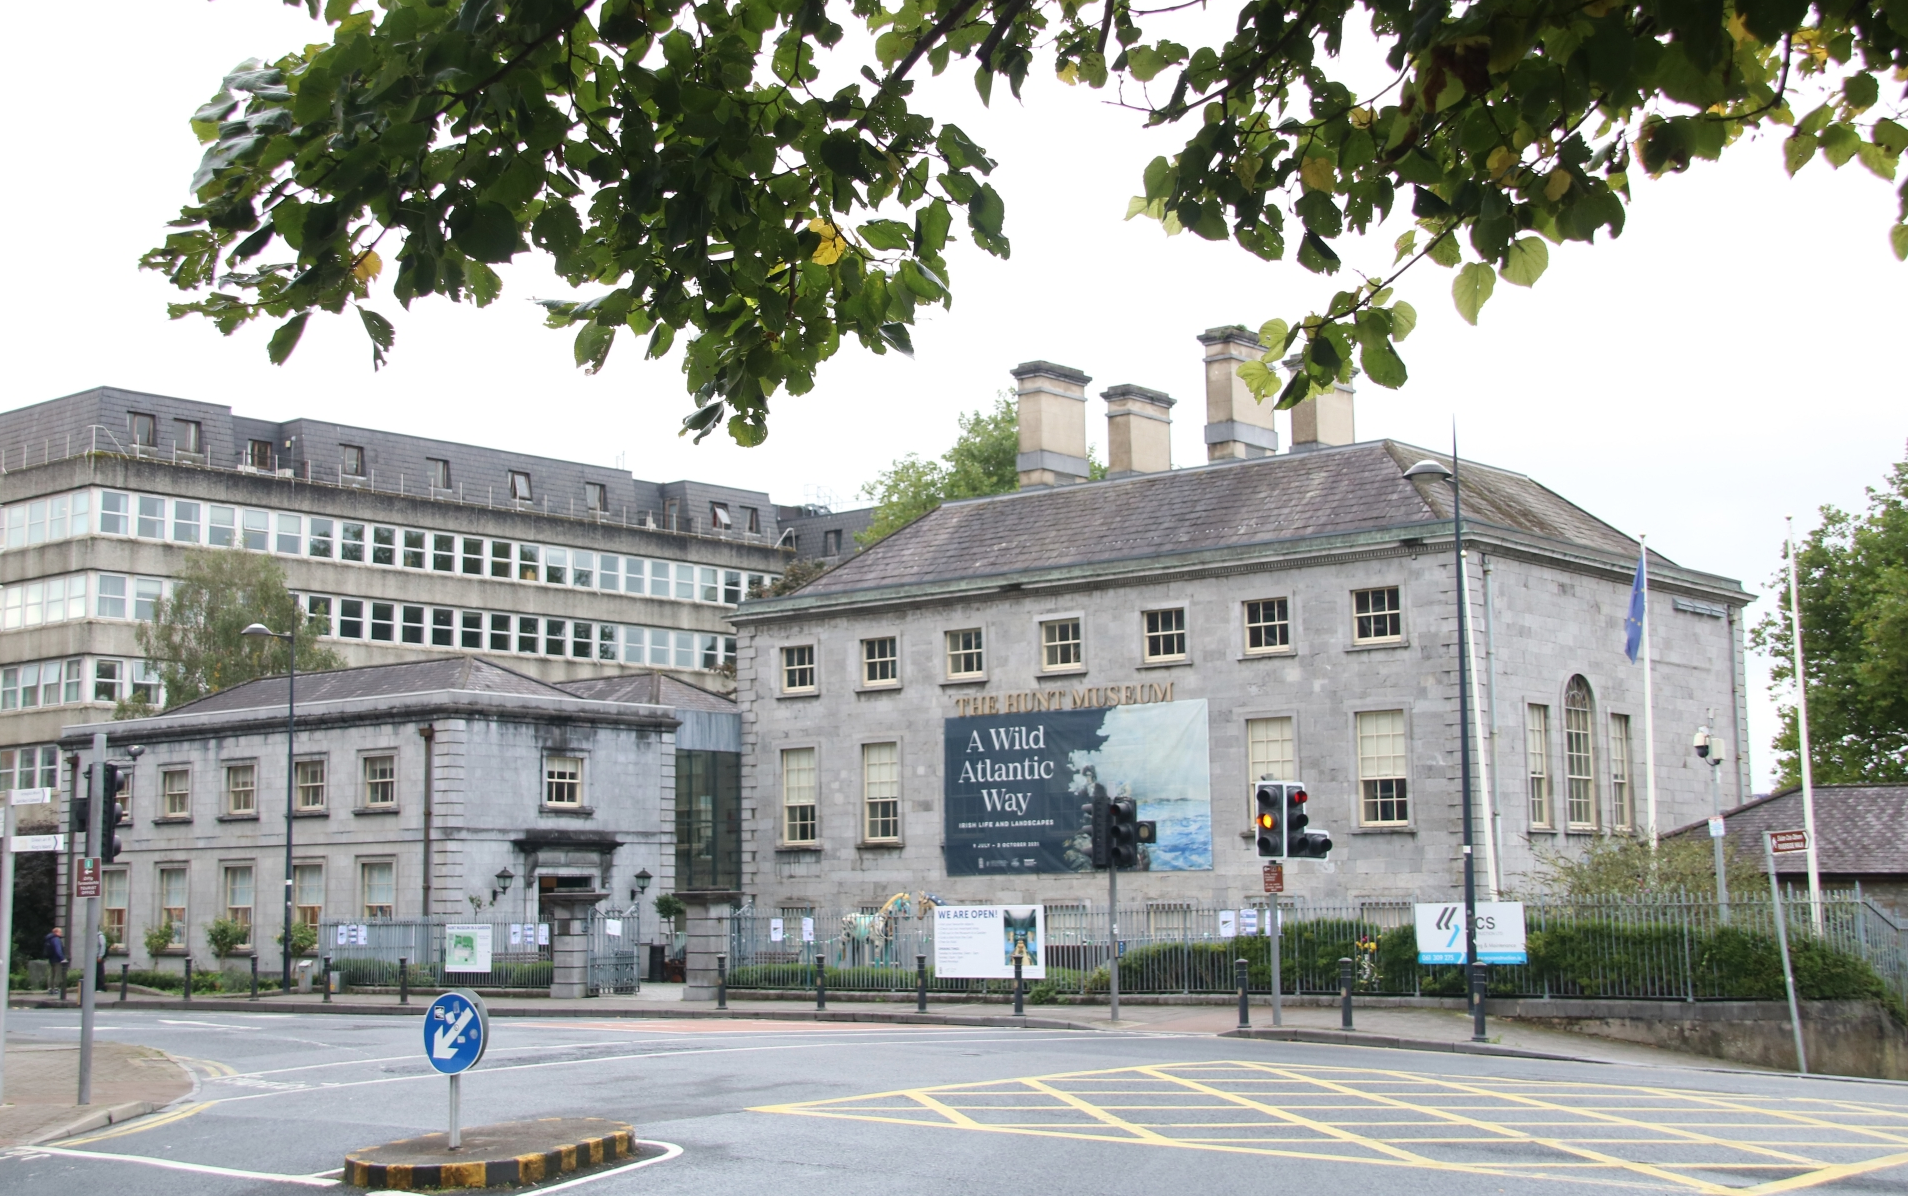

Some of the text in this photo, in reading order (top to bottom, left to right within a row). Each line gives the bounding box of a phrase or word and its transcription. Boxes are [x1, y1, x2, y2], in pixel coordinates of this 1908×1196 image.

[956, 682, 1174, 717] THE HUNT MUSEUM
[966, 725, 1046, 752] A Wild
[958, 756, 1054, 783] Atlantic
[981, 789, 1032, 816] Way
[1011, 819, 1054, 827] LANDSCAPES
[938, 909, 998, 919] WE ARE OPEN!
[1475, 916, 1495, 930] CS
